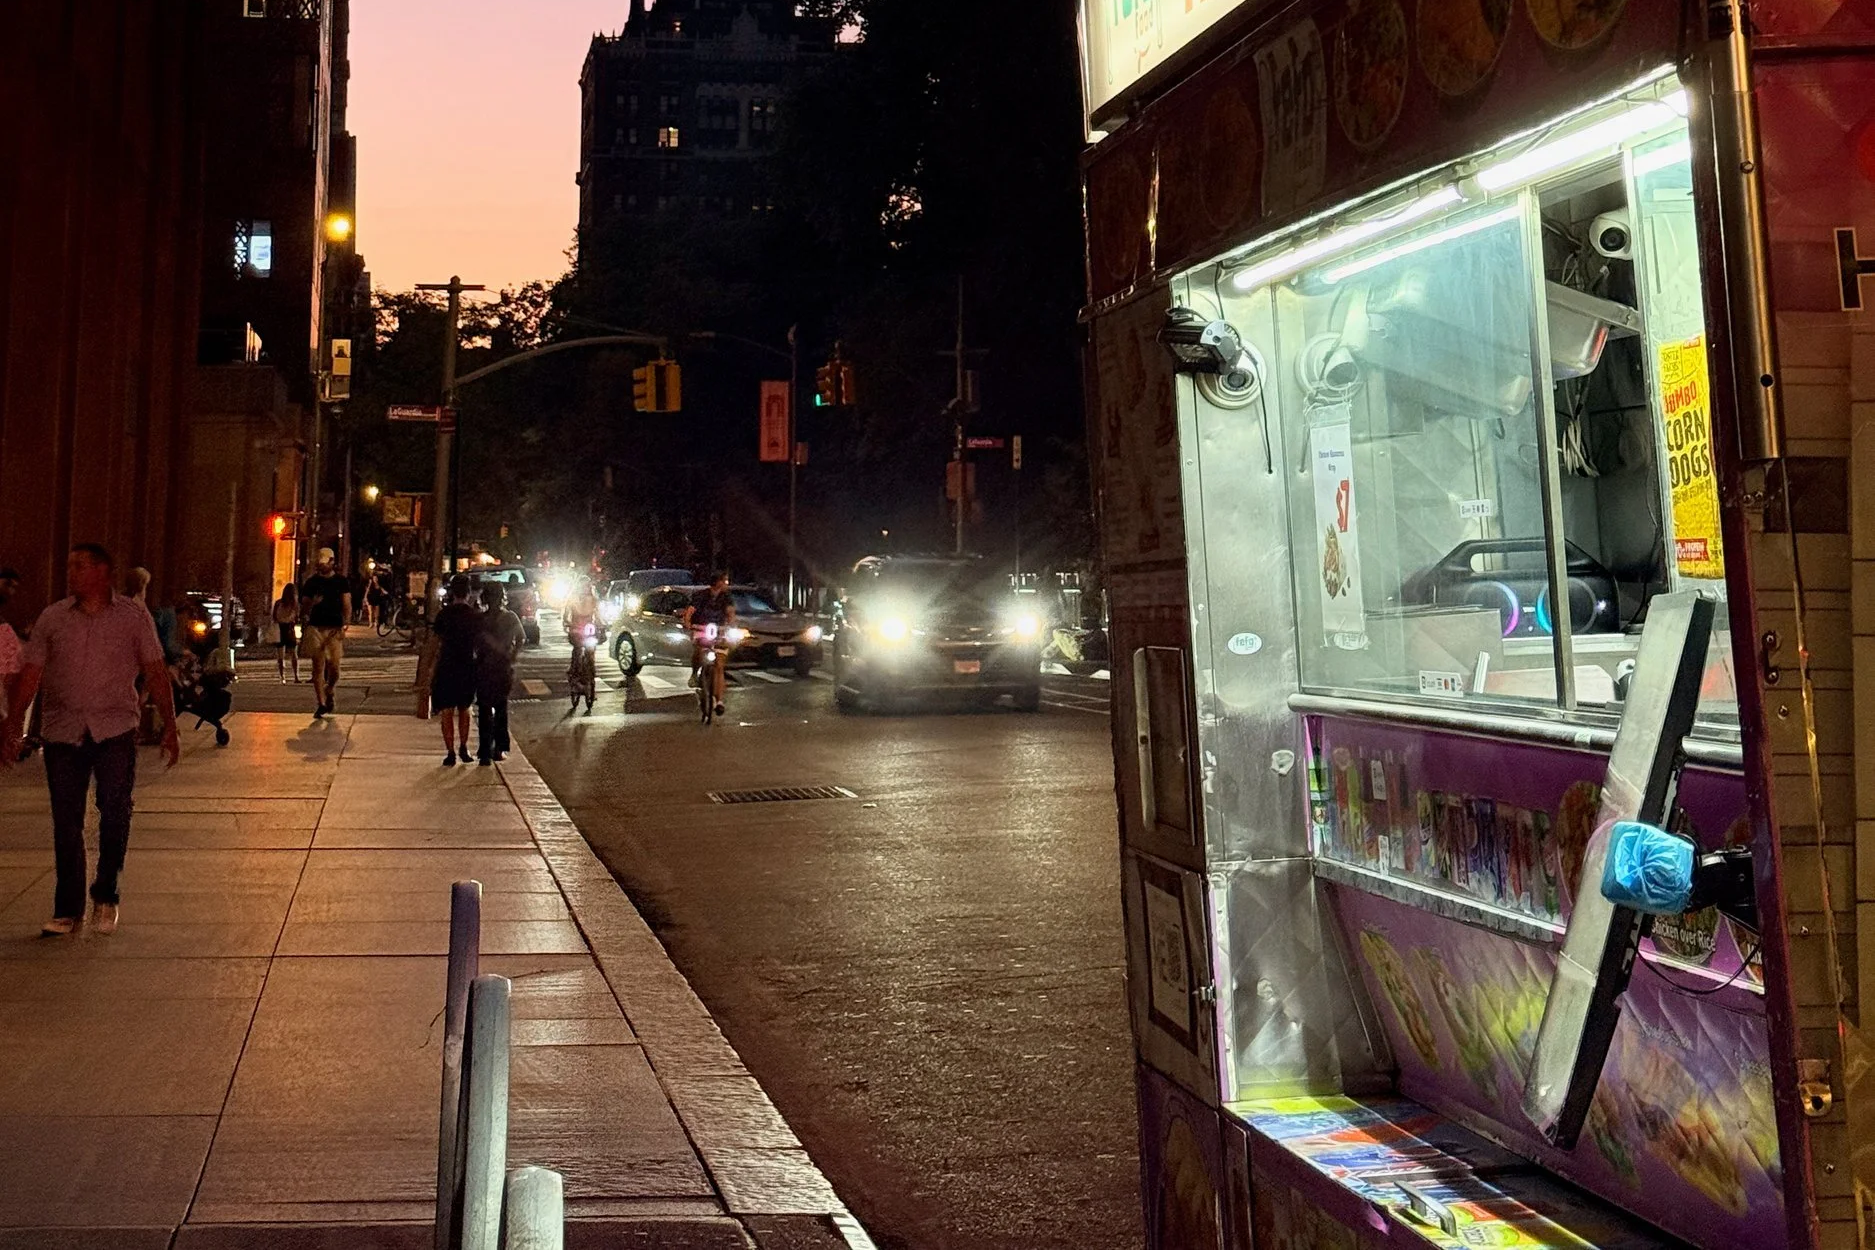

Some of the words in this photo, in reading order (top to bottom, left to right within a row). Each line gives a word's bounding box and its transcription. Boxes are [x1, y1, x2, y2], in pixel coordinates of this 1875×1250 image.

[1664, 380, 1697, 414] JUMBO
[1665, 406, 1706, 452] CORN
[1669, 442, 1710, 489] DOGS
[1680, 928, 1697, 946] over
[1698, 929, 1716, 952] Rice
